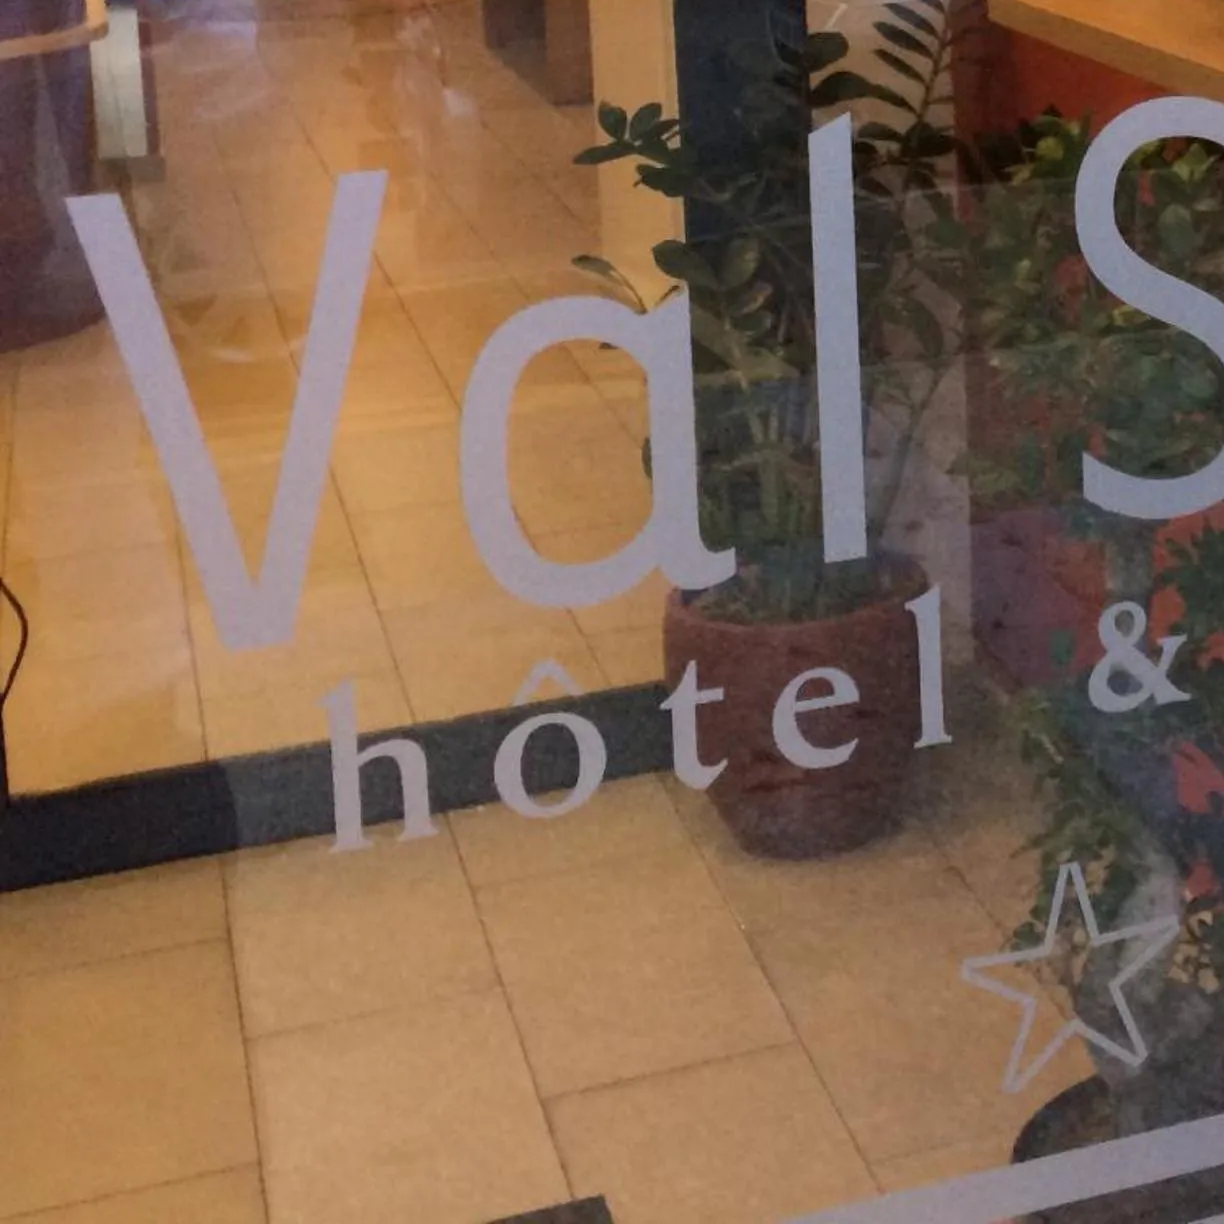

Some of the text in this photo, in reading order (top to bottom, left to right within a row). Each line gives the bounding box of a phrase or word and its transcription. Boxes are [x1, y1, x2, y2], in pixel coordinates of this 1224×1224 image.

[65, 111, 868, 654] Val
[317, 586, 953, 854] hôtel
[1087, 601, 1192, 713] &
